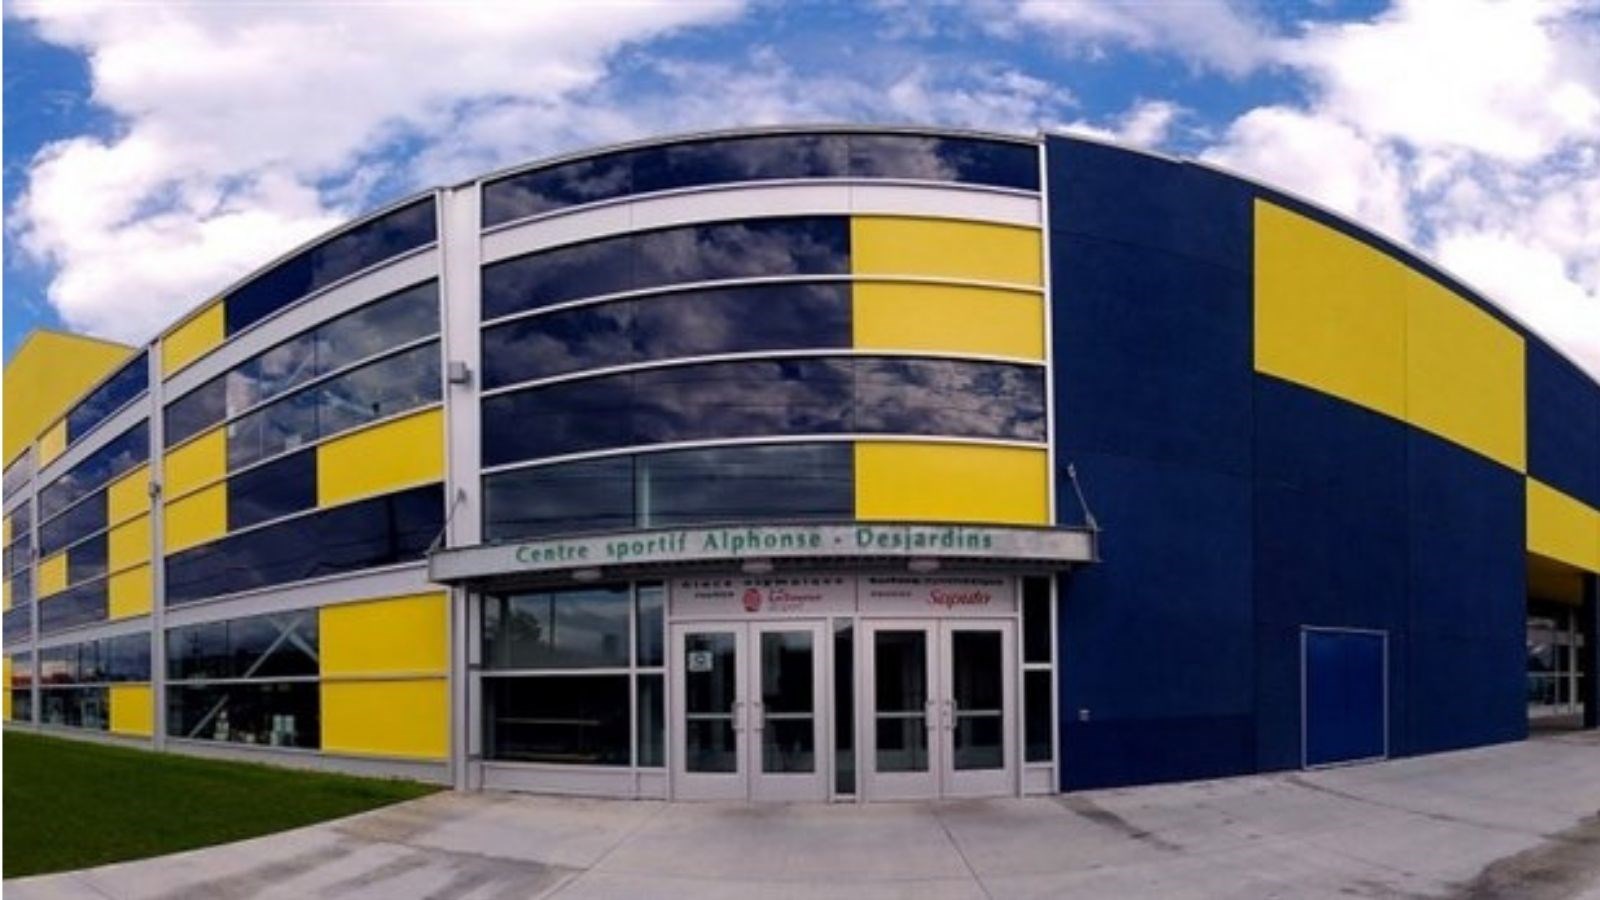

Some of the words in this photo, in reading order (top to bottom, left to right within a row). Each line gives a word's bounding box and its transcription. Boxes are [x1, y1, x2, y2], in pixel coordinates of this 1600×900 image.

[515, 544, 589, 563] Centre
[605, 532, 687, 559] sportif
[702, 529, 822, 555] Alphonse
[857, 527, 993, 550] Desjardins
